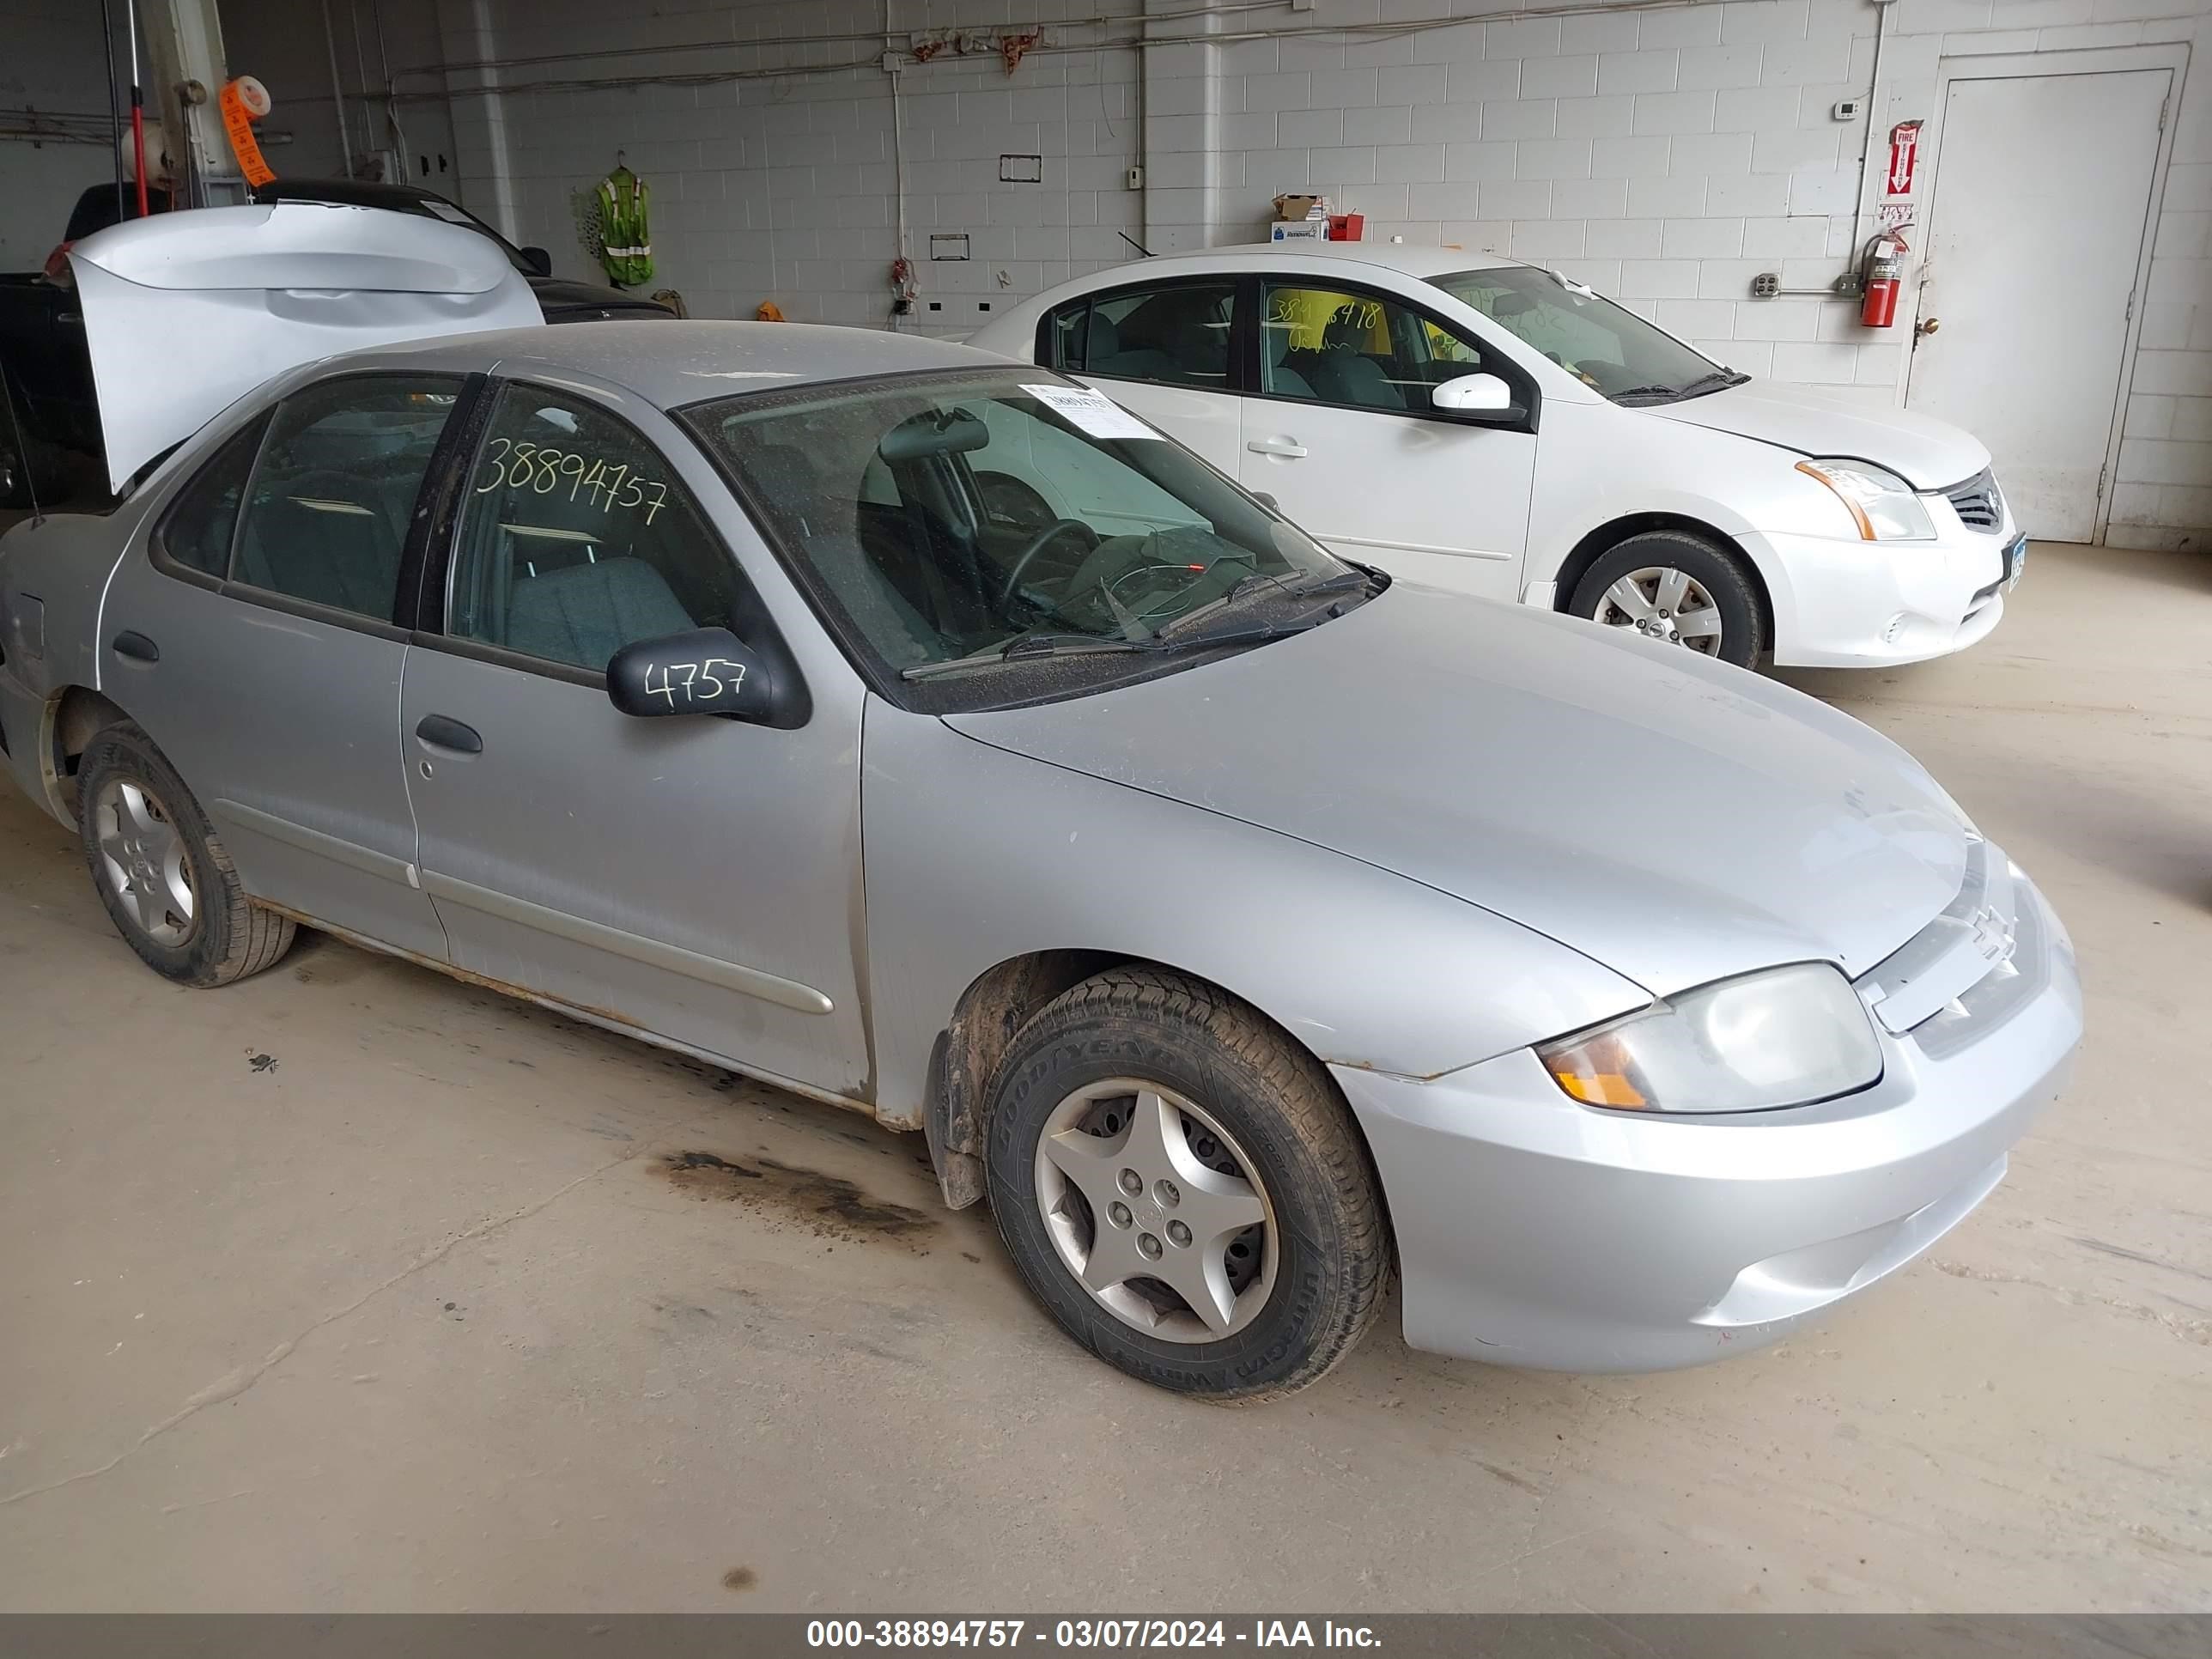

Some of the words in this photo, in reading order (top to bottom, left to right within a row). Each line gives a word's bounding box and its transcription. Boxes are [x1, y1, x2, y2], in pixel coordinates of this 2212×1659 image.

[1898, 132, 1914, 142] FIRE
[477, 439, 667, 526] 38894757
[645, 659, 746, 708] 4757
